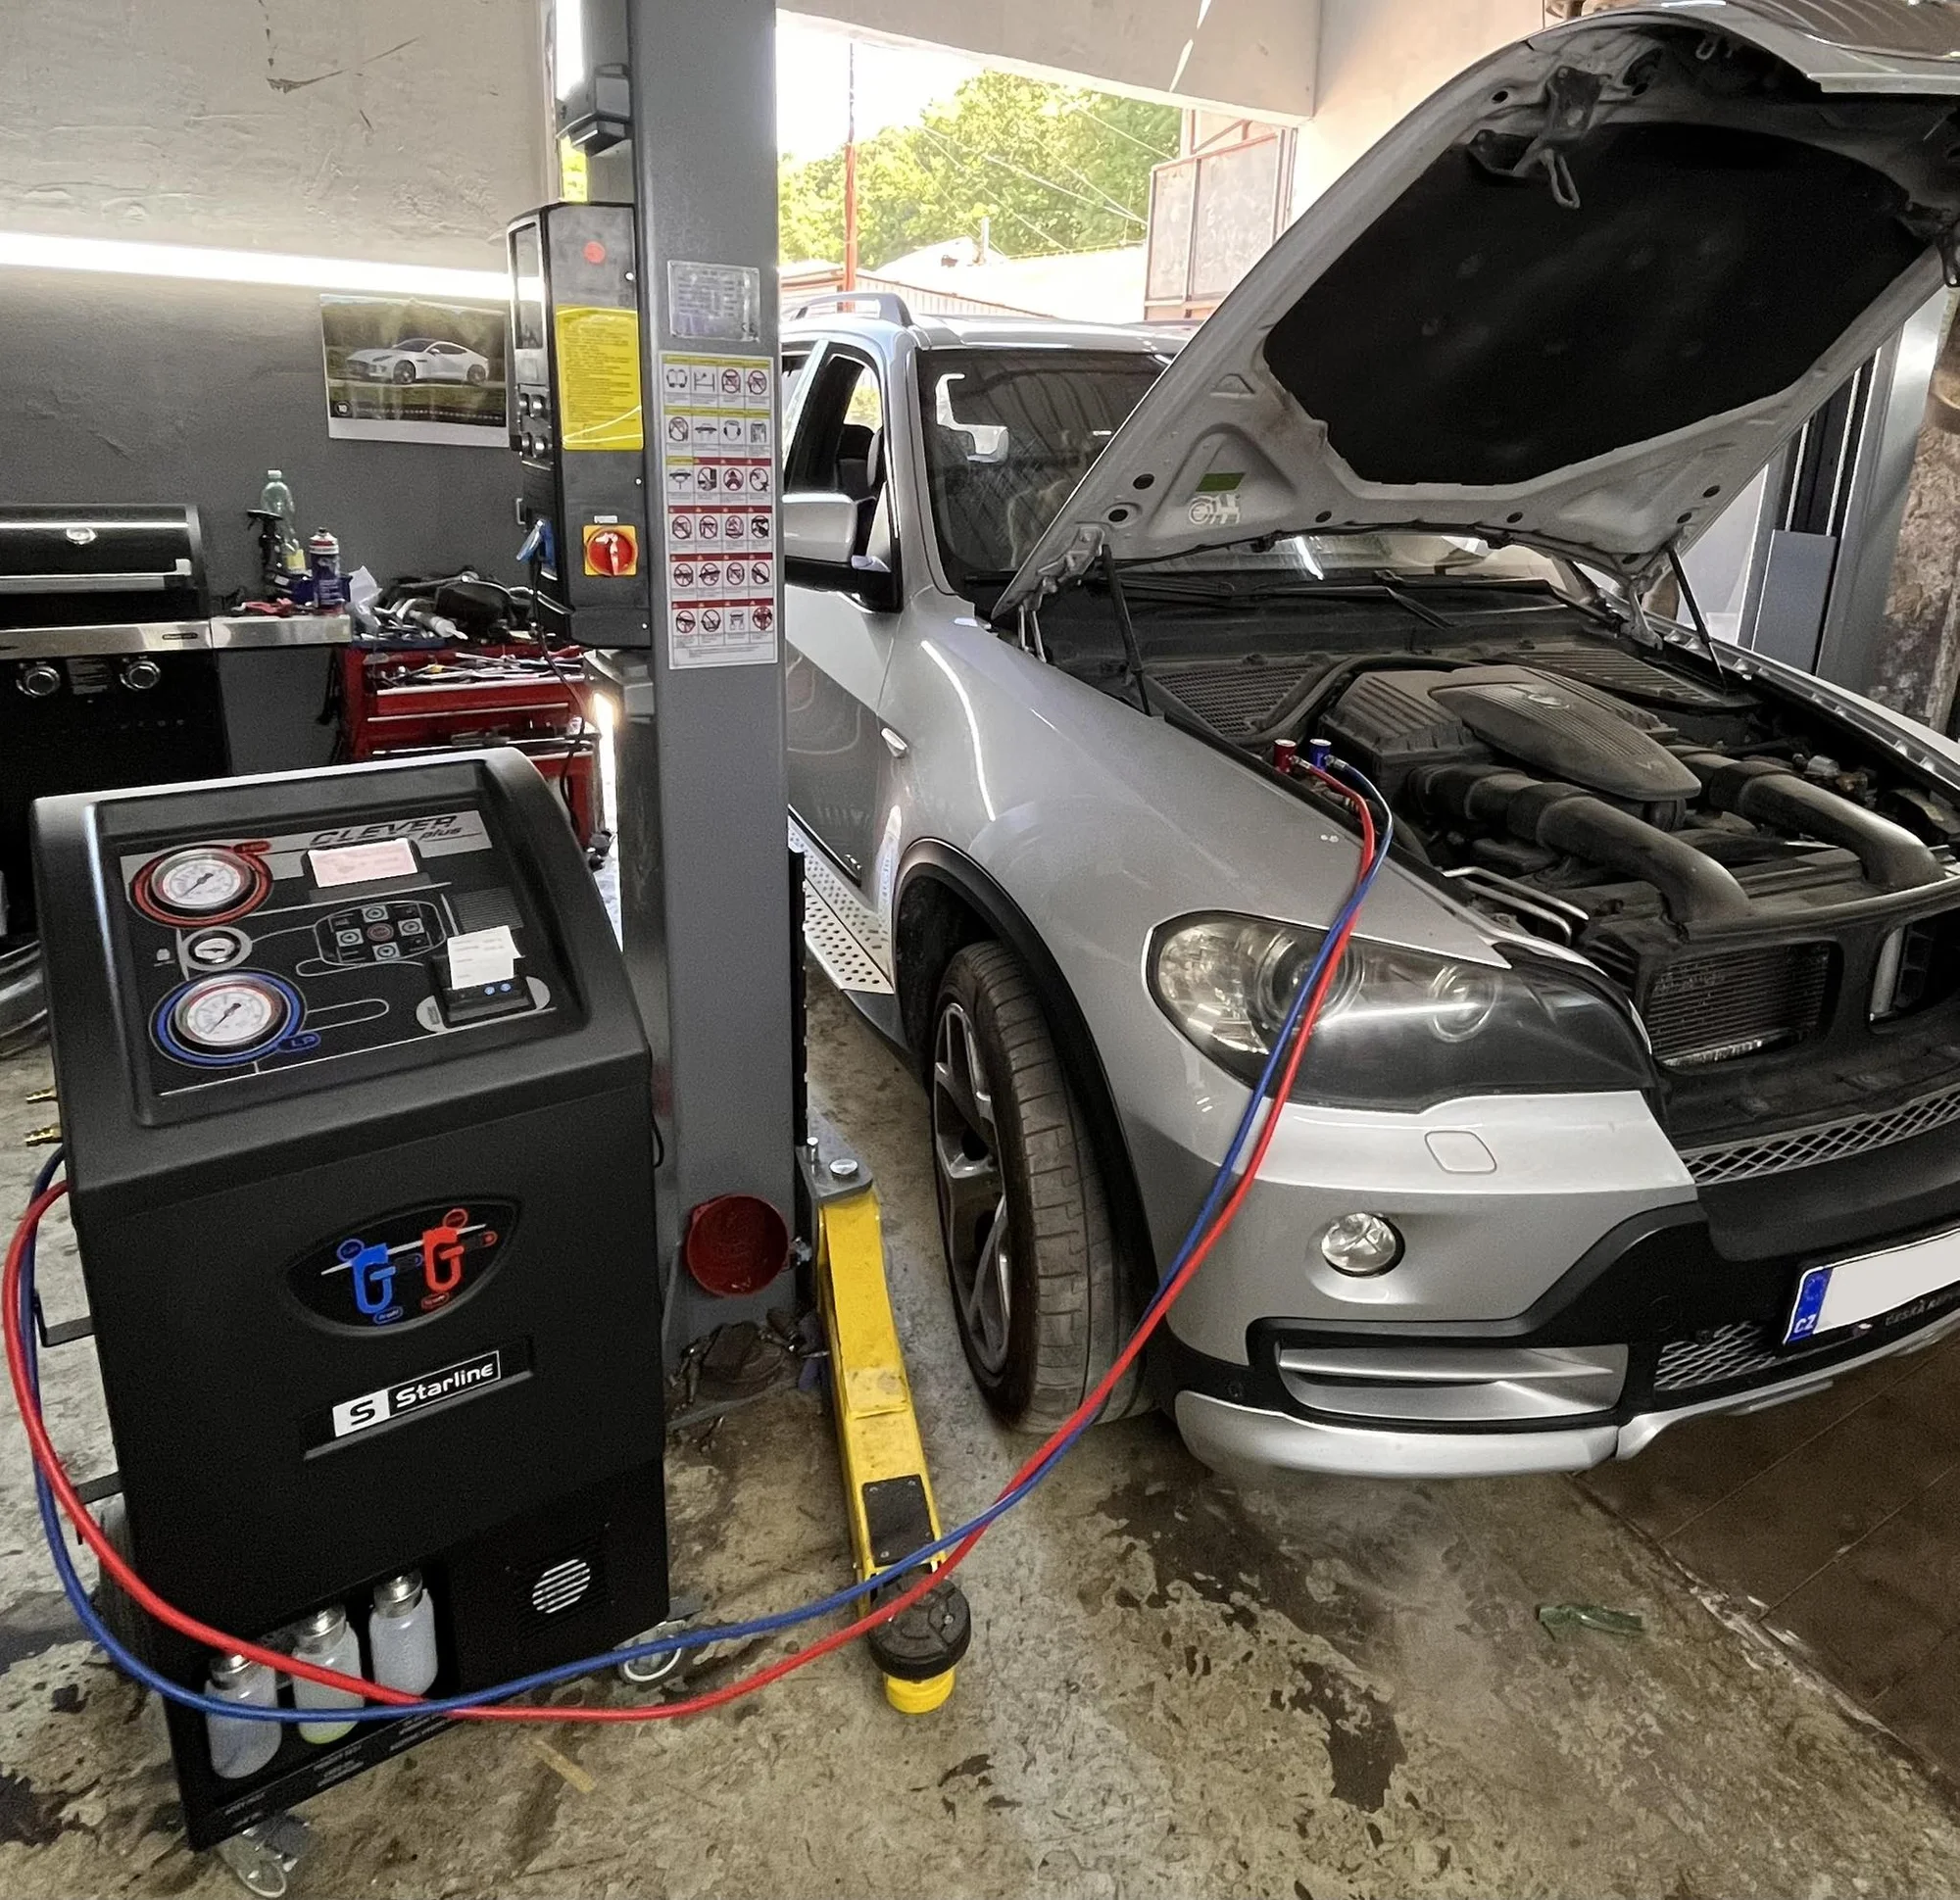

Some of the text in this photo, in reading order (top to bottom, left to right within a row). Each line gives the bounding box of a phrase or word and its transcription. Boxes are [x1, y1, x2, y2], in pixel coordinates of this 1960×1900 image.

[310, 815, 458, 846] CLEVER
[417, 826, 463, 841] plus
[1793, 1314, 1817, 1334] CZ
[349, 1363, 494, 1427] S Starline
